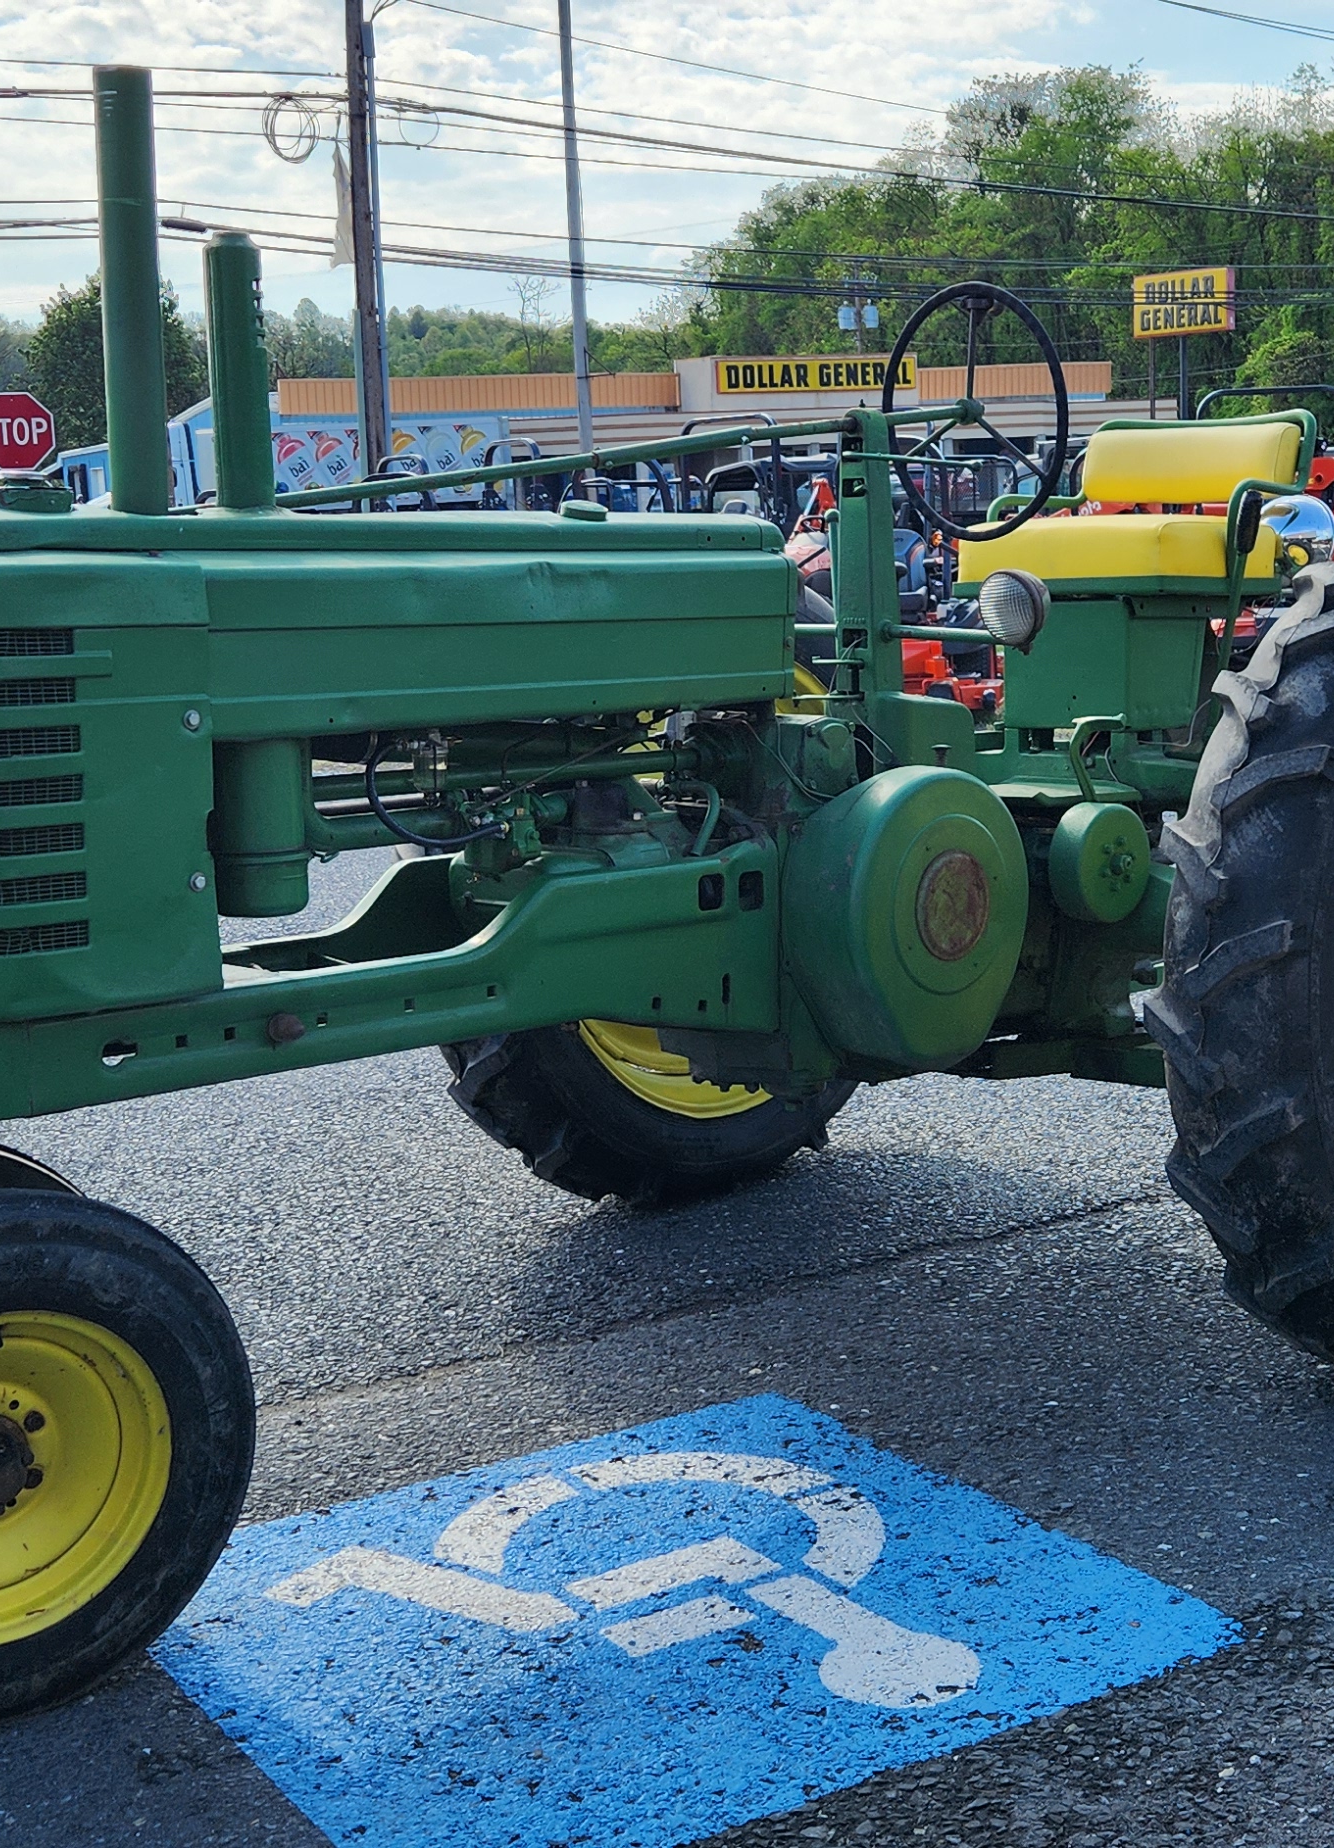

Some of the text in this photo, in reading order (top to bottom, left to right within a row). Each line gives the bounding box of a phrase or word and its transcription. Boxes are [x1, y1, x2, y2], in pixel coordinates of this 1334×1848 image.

[1144, 274, 1215, 303] DOLLAR
[1140, 304, 1222, 332] GENERAL
[725, 362, 810, 390] DOLLAR
[288, 456, 310, 478] bai
[327, 454, 348, 476] bai
[436, 449, 456, 470] bai
